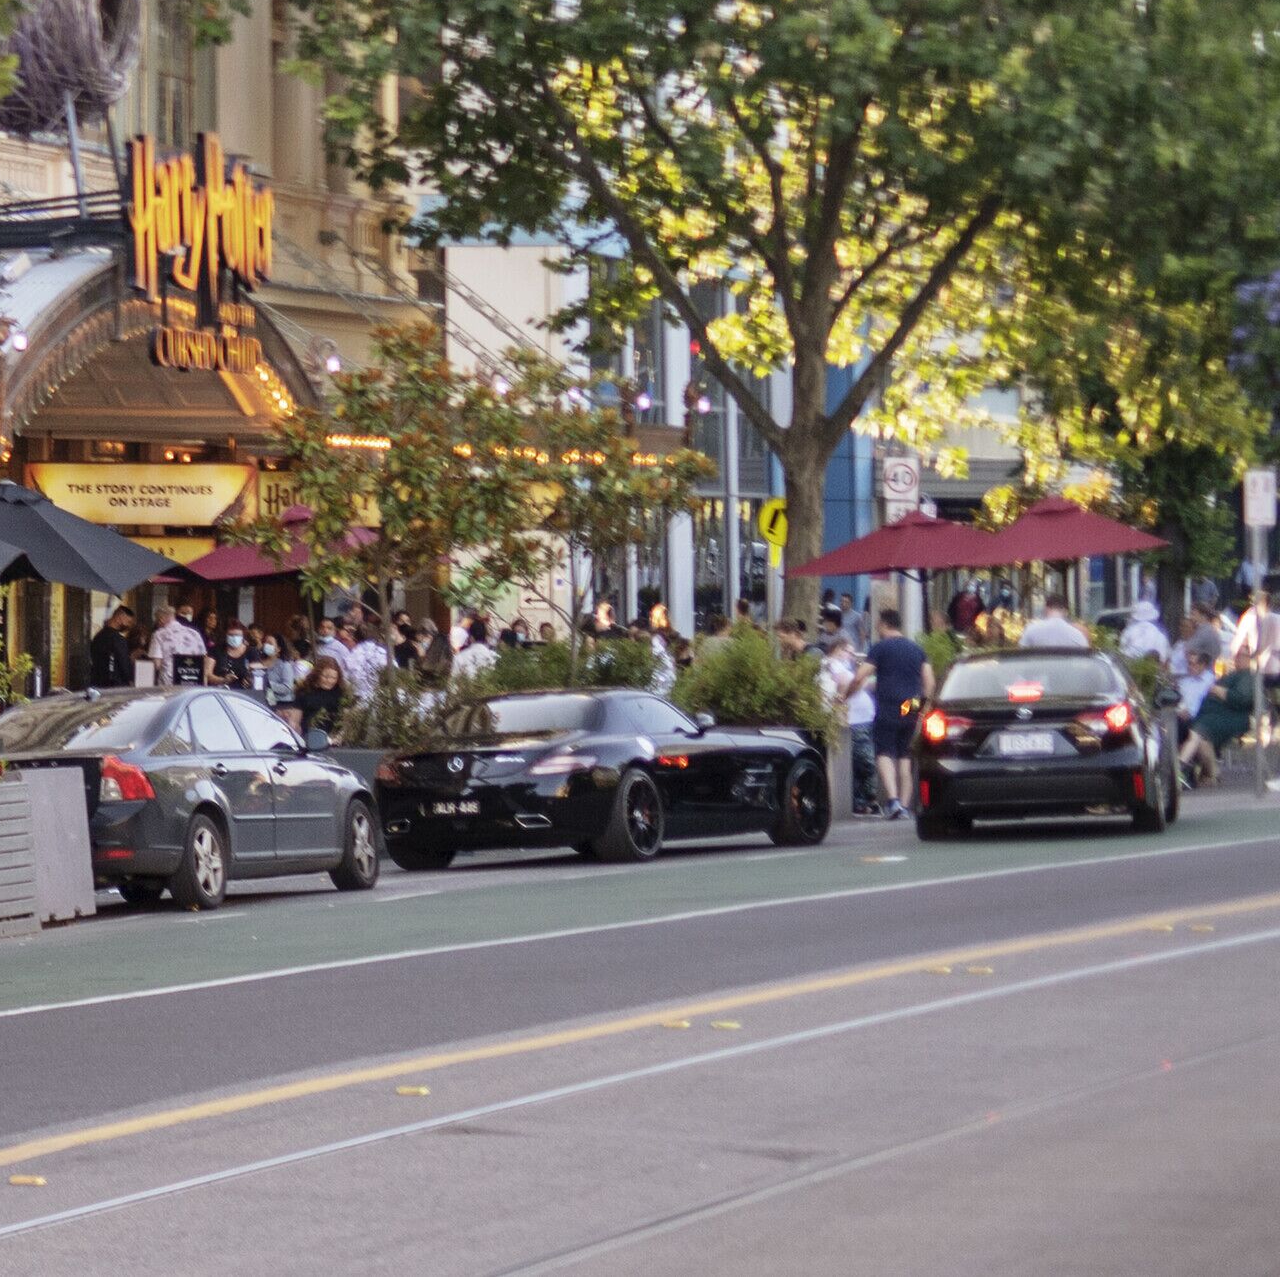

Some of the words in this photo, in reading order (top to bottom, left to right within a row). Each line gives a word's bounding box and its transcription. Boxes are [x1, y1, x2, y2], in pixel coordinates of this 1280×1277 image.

[67, 483, 93, 494] THE
[95, 483, 135, 495] STORY
[138, 484, 214, 496] CONTINUES
[108, 497, 128, 507] ON
[131, 497, 172, 508] STAGE
